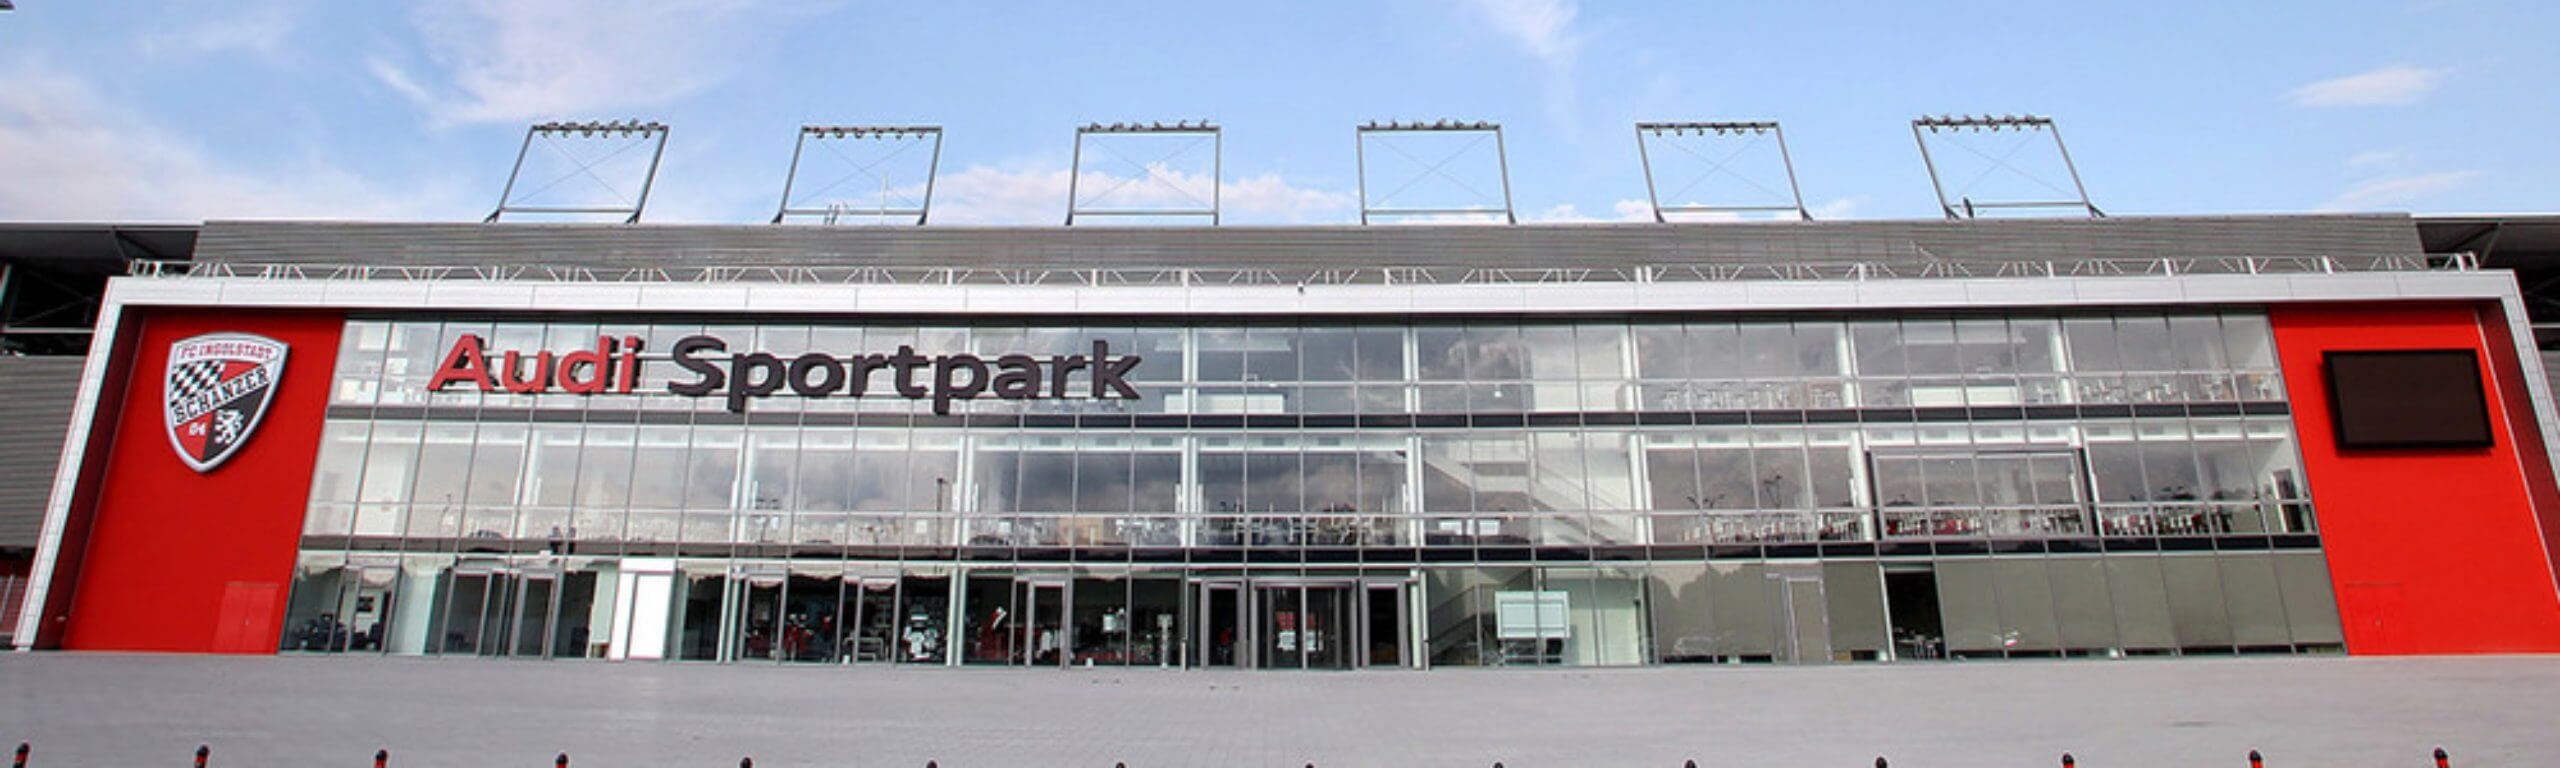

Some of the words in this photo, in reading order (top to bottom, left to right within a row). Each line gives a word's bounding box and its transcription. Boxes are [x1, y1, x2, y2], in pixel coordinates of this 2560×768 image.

[199, 344, 273, 358] INGOLSTADT
[427, 335, 638, 395] Audi
[668, 335, 1142, 414] Sportpark
[174, 367, 269, 424] SCHANZER
[189, 423, 207, 435] 04
